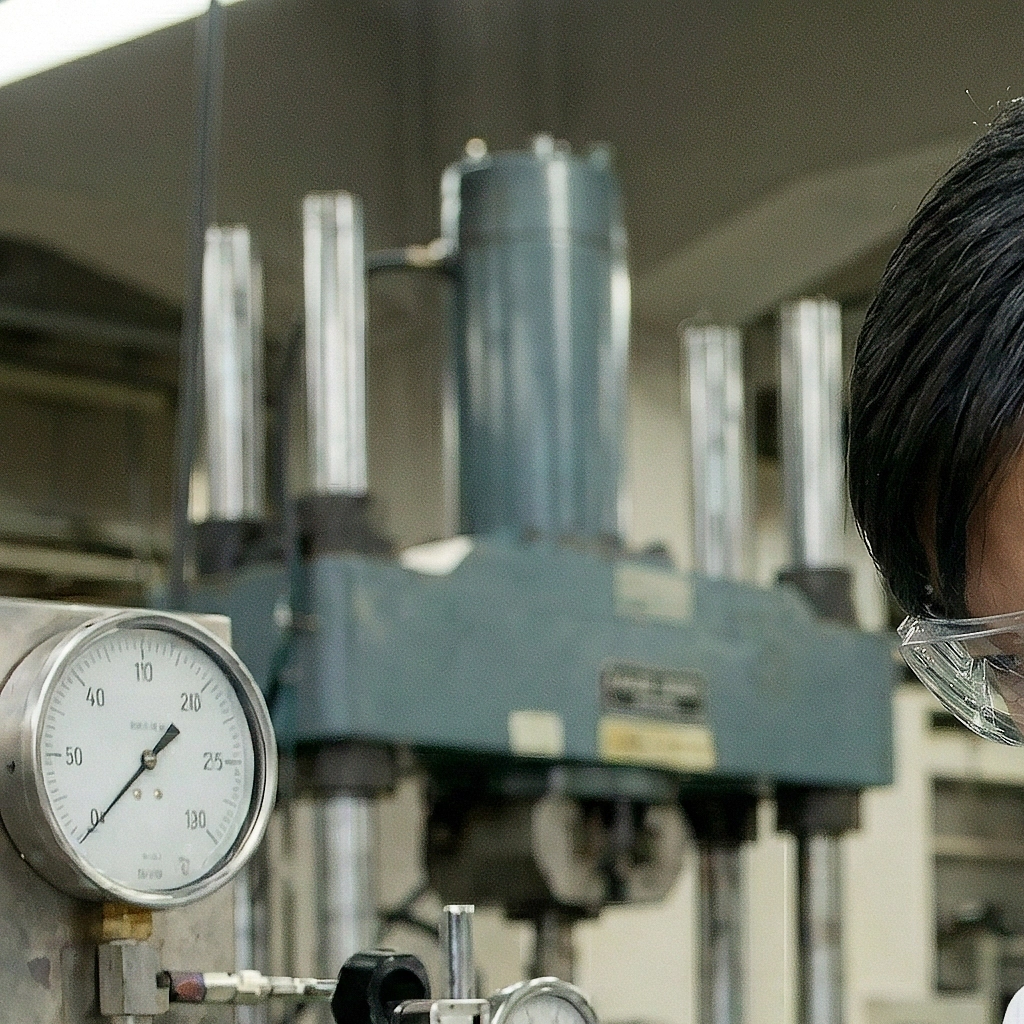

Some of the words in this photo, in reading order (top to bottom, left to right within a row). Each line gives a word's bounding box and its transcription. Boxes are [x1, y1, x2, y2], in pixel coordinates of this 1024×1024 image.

[86, 686, 105, 707] 40
[65, 746, 83, 766] 50
[203, 752, 223, 771] 25
